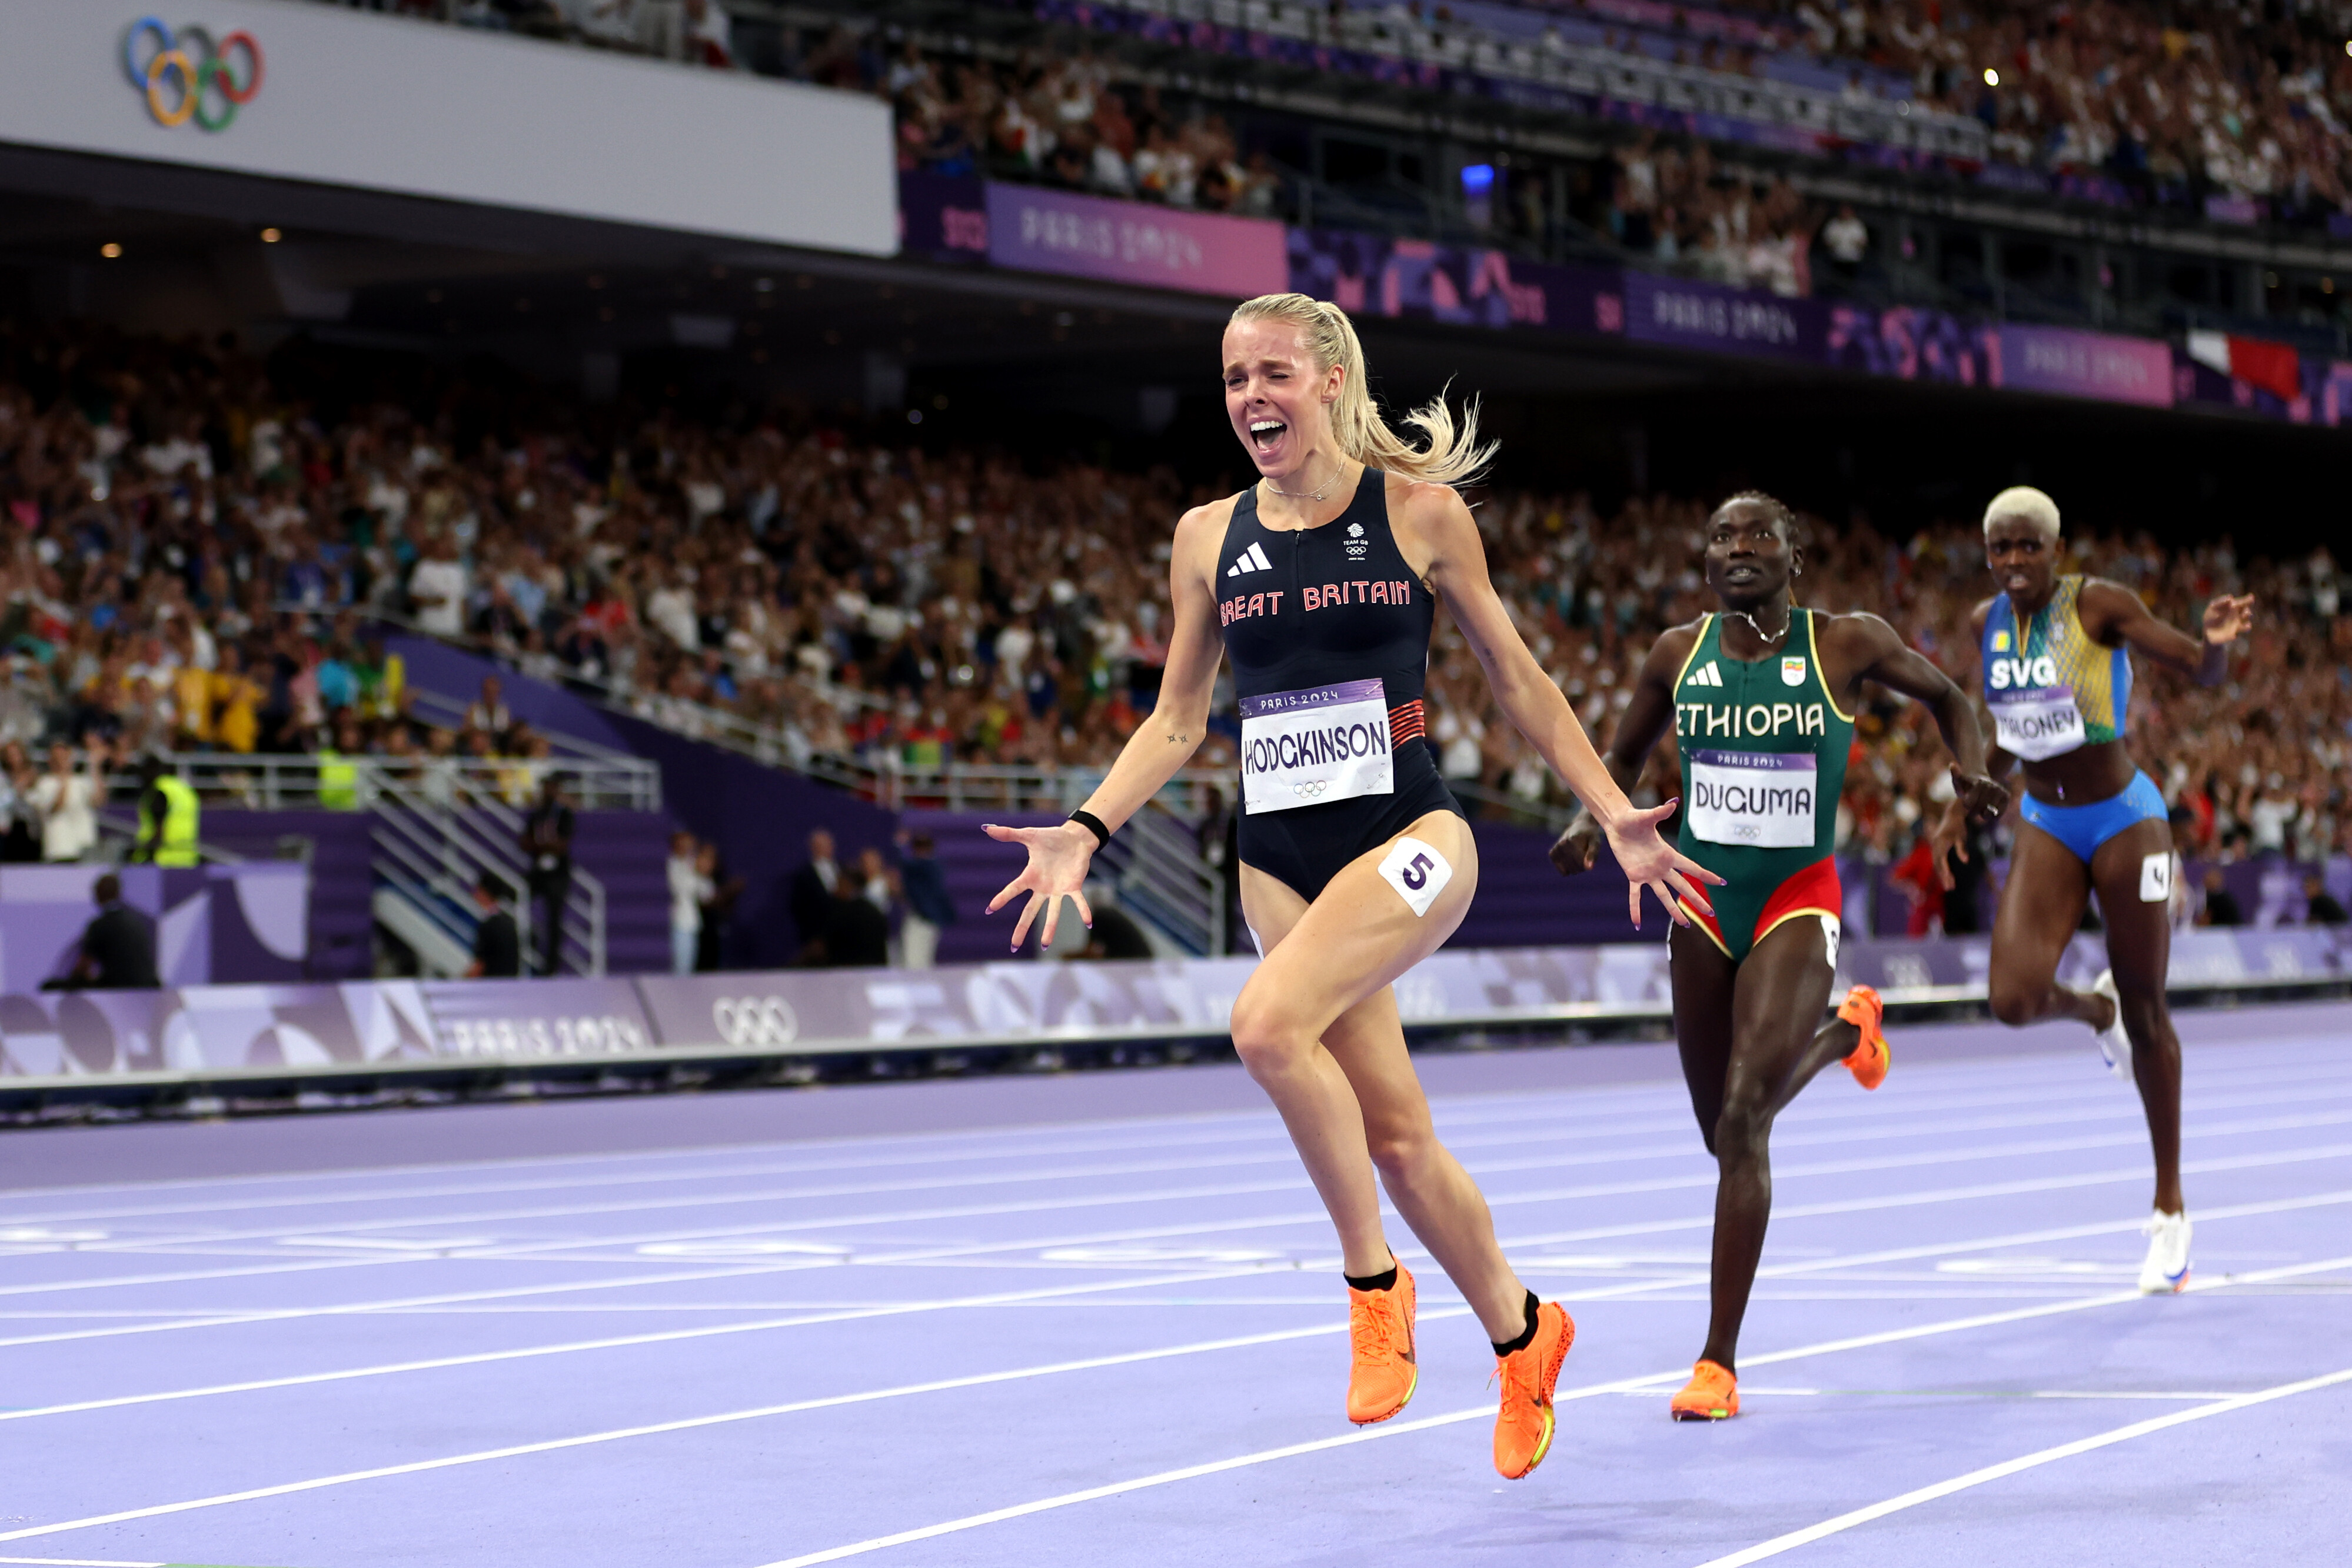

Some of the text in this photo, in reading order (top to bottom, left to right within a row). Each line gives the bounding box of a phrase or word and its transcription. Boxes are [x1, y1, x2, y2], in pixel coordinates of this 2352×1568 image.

[1220, 581, 1410, 627] GREAT BRITAIN
[1990, 655, 2057, 690] SVG
[1261, 690, 1338, 710] PARIS 2024
[1676, 703, 1825, 737] ETHIOPIA
[1245, 721, 1386, 775] HODGKINSON
[1718, 754, 1783, 768] PARIS 2024
[1696, 781, 1811, 816] DUGUMA
[1402, 852, 1435, 891] 5
